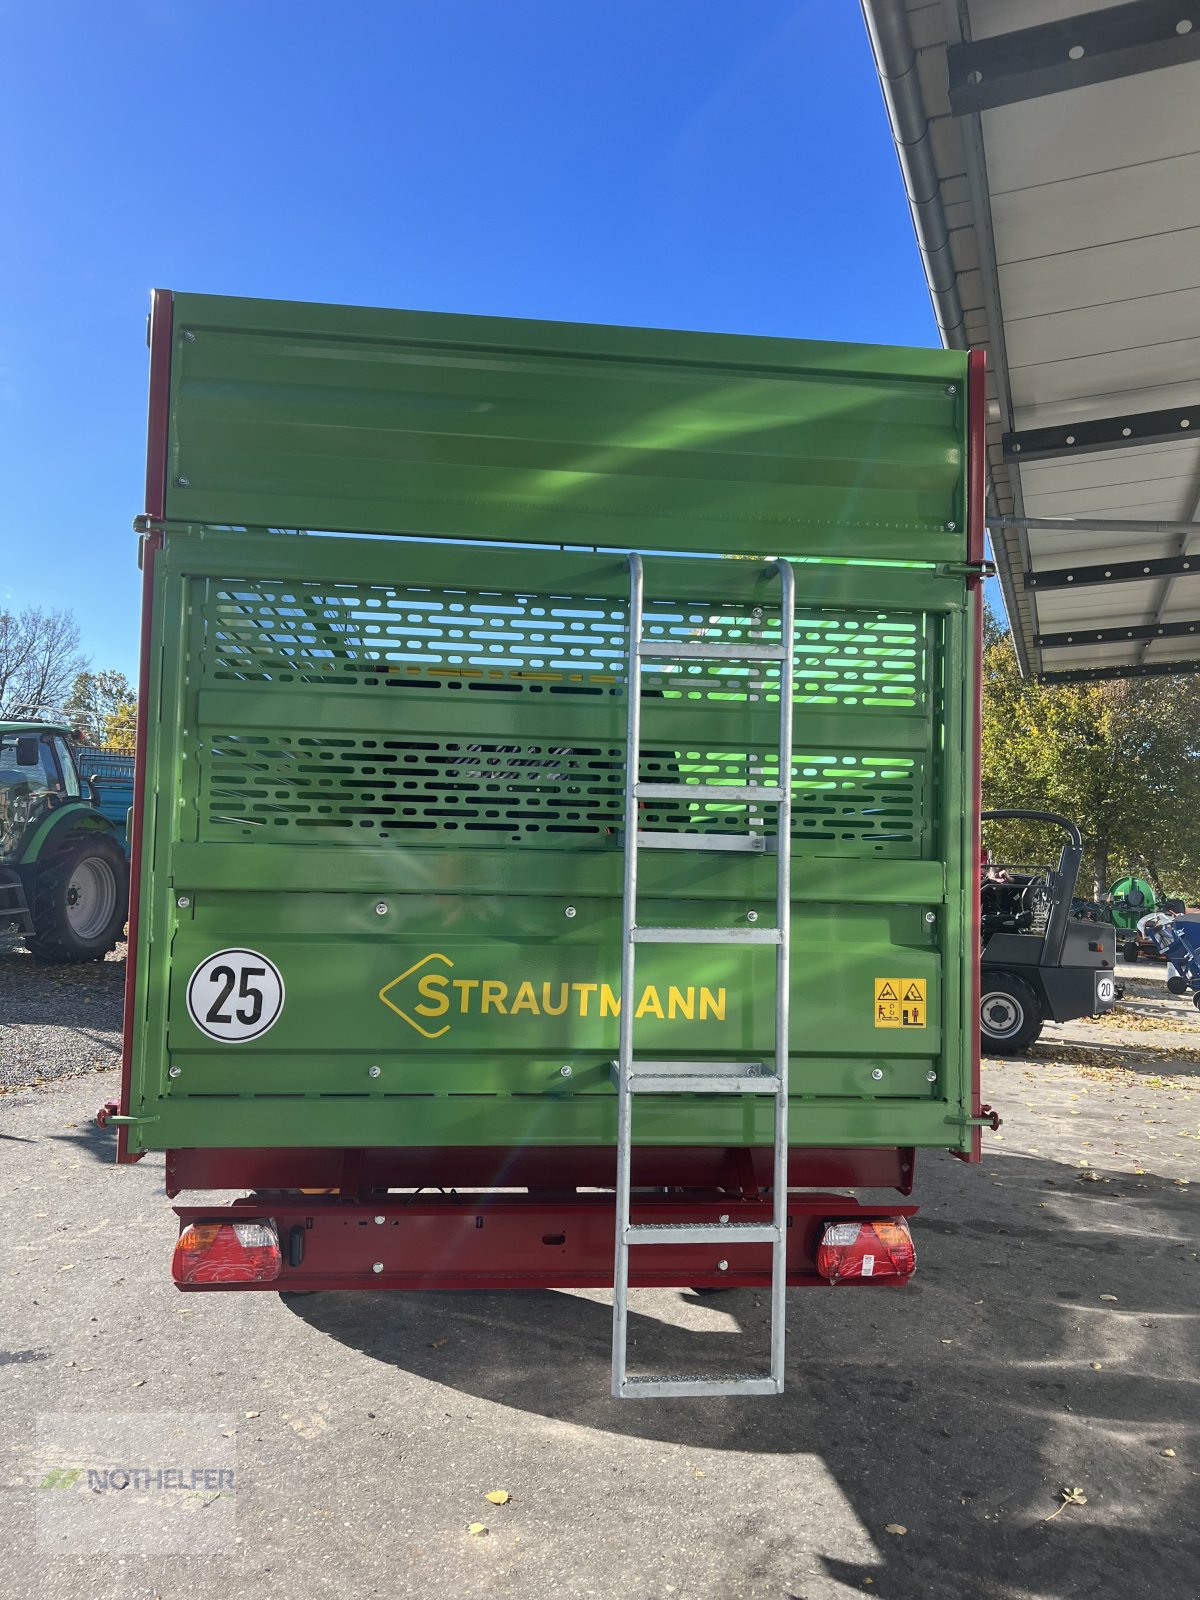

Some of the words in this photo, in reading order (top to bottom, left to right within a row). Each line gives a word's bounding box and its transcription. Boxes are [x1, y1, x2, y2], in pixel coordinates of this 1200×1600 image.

[205, 965, 266, 1026] 25
[413, 974, 727, 1022] STRAUTMANN
[1101, 982, 1111, 997] 20
